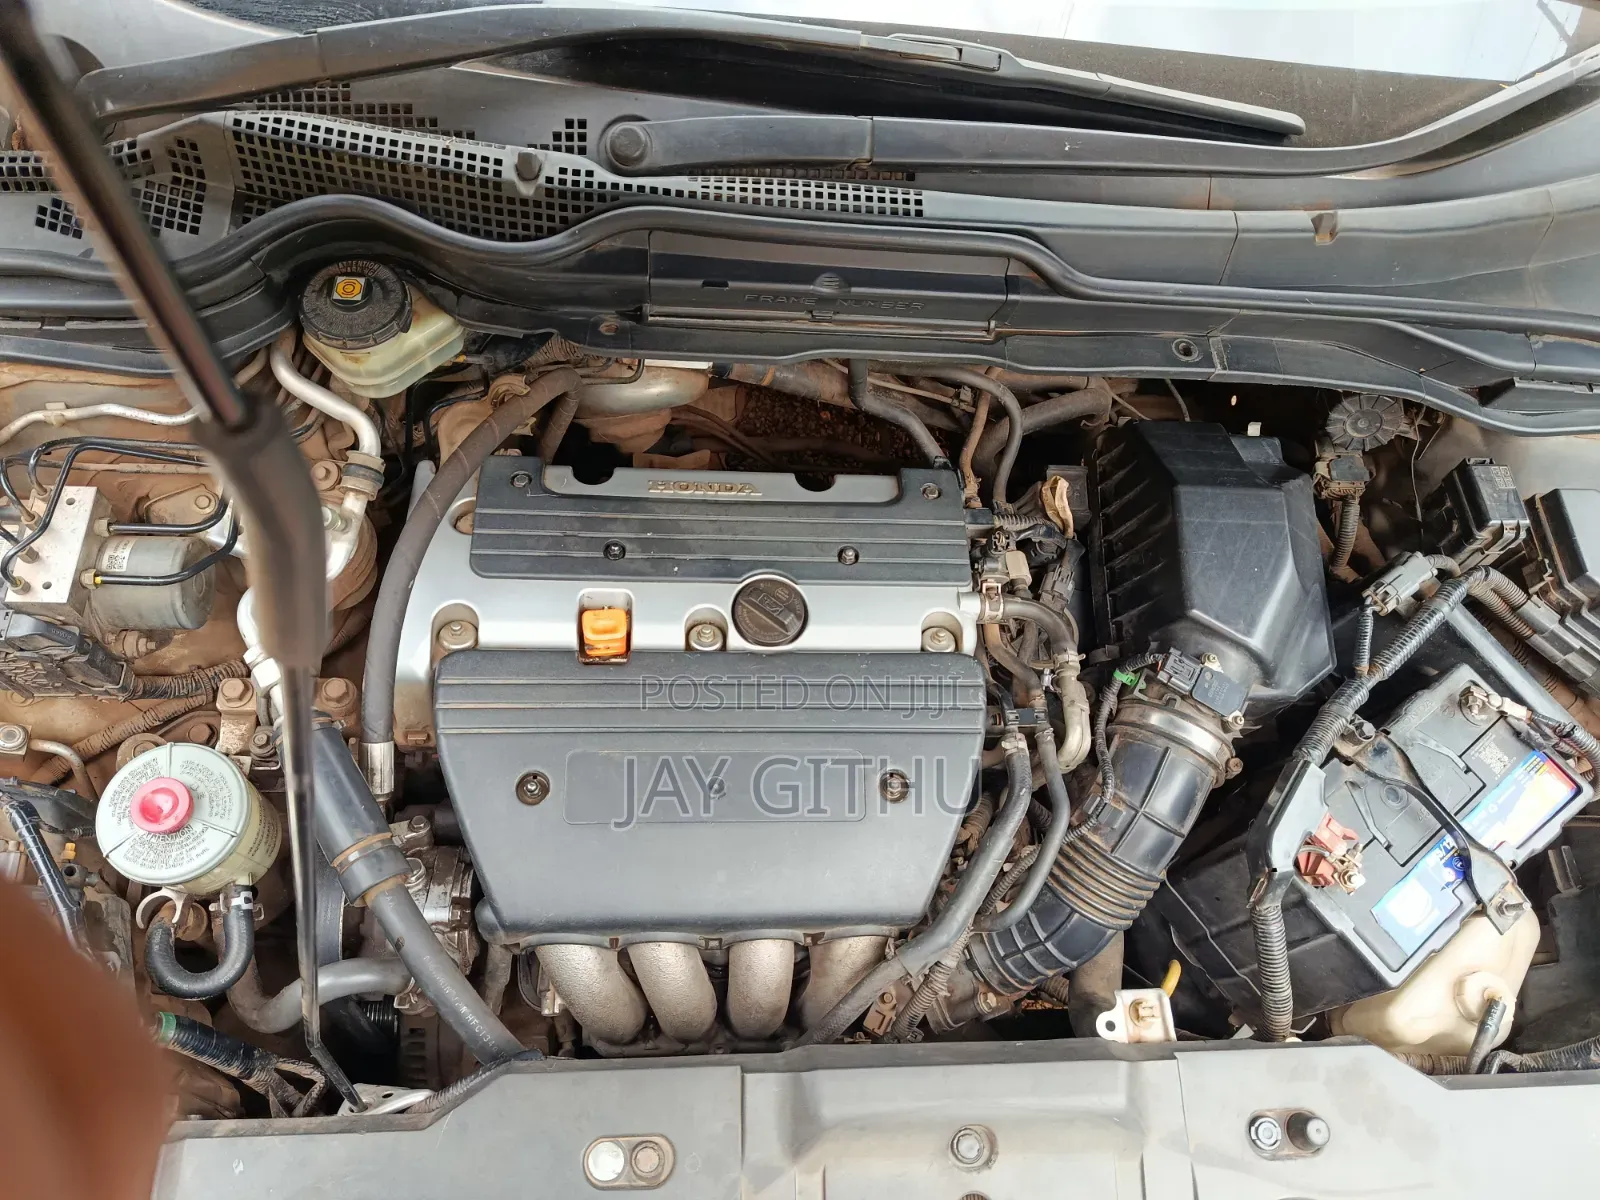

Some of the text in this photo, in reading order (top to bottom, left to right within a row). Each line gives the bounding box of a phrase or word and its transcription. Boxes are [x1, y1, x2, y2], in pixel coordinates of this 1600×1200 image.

[338, 260, 381, 271] ATTENTION
[744, 294, 925, 310] FRAME NUMBER
[648, 480, 762, 495] HONDA
[141, 823, 194, 842] ATTENTION
